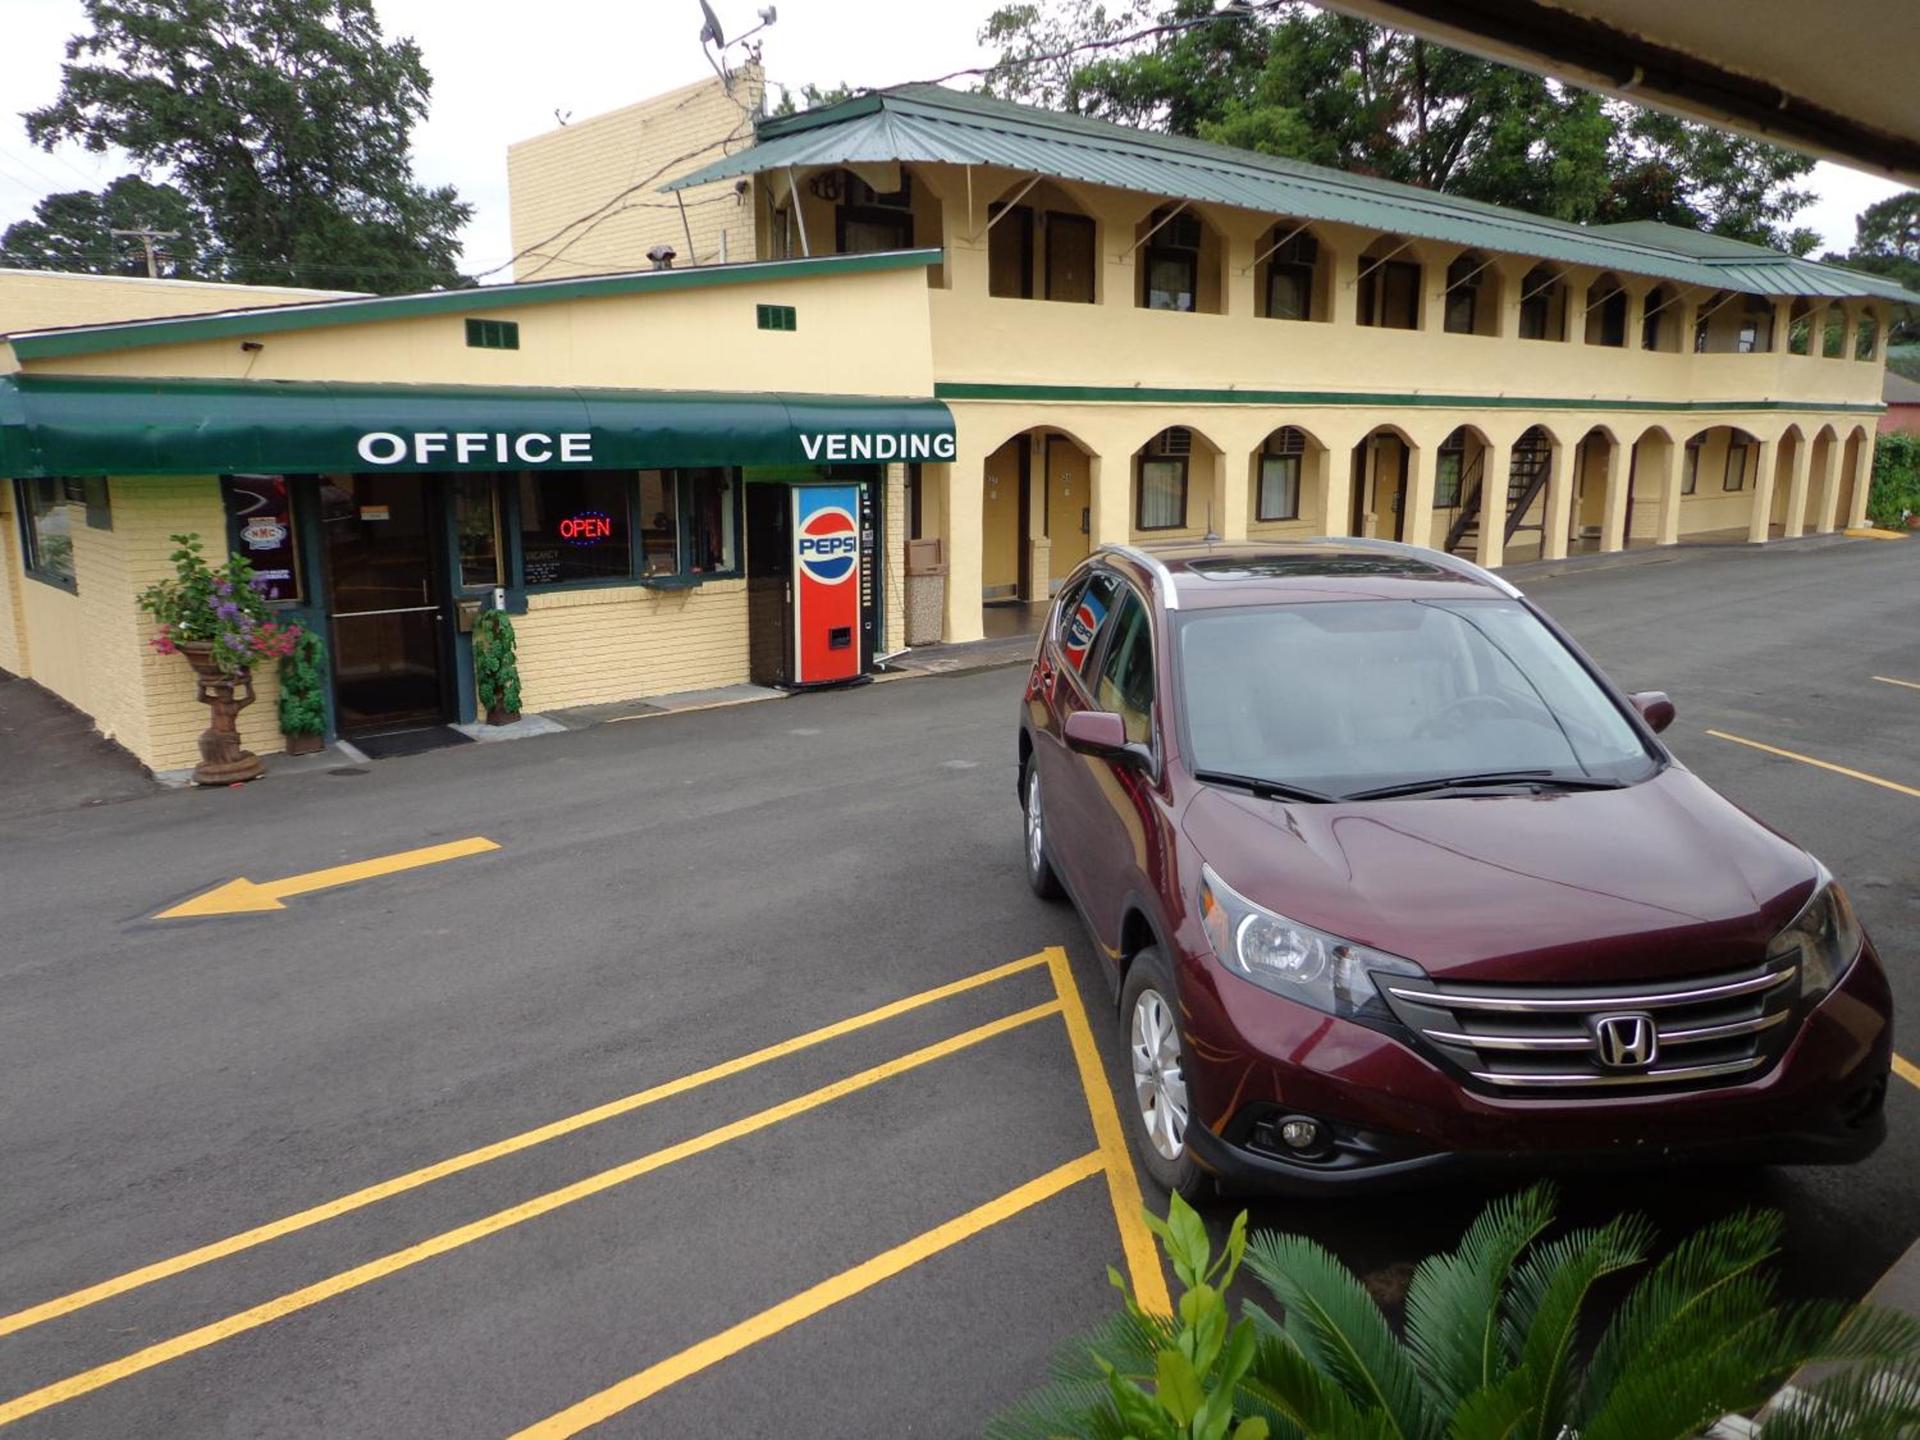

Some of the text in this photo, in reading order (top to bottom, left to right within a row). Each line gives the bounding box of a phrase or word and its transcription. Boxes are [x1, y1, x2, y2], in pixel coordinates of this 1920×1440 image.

[357, 432, 593, 464] OFFICE
[800, 433, 955, 460] VENDING
[560, 518, 611, 538] OPEN
[799, 536, 857, 555] PEPSI
